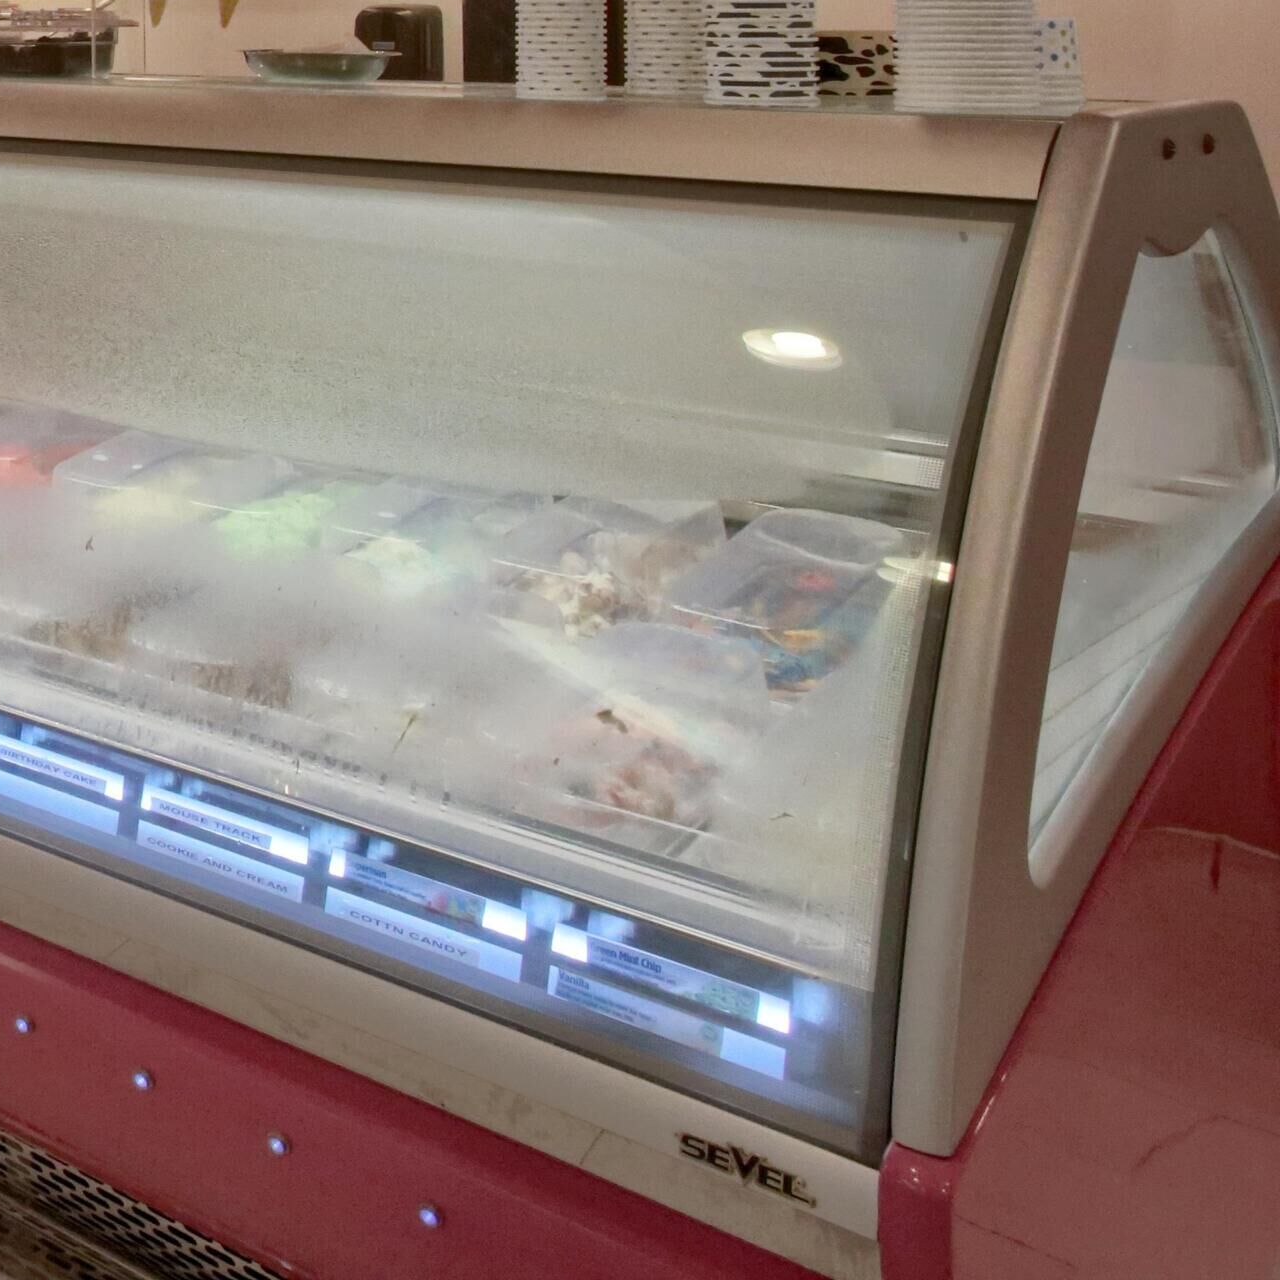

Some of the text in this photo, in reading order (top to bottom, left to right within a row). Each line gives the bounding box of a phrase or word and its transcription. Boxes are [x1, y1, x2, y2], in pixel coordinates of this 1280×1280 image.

[0, 747, 97, 786] BIRTHDAY CAKE
[159, 802, 261, 843] MOUSE TRACK
[146, 836, 288, 893] COOKIE AND CREAM
[349, 910, 467, 958] COTTN CANDY
[559, 969, 590, 989] Vanilla
[641, 958, 662, 974] Chip
[677, 1133, 817, 1208] SEVEL
